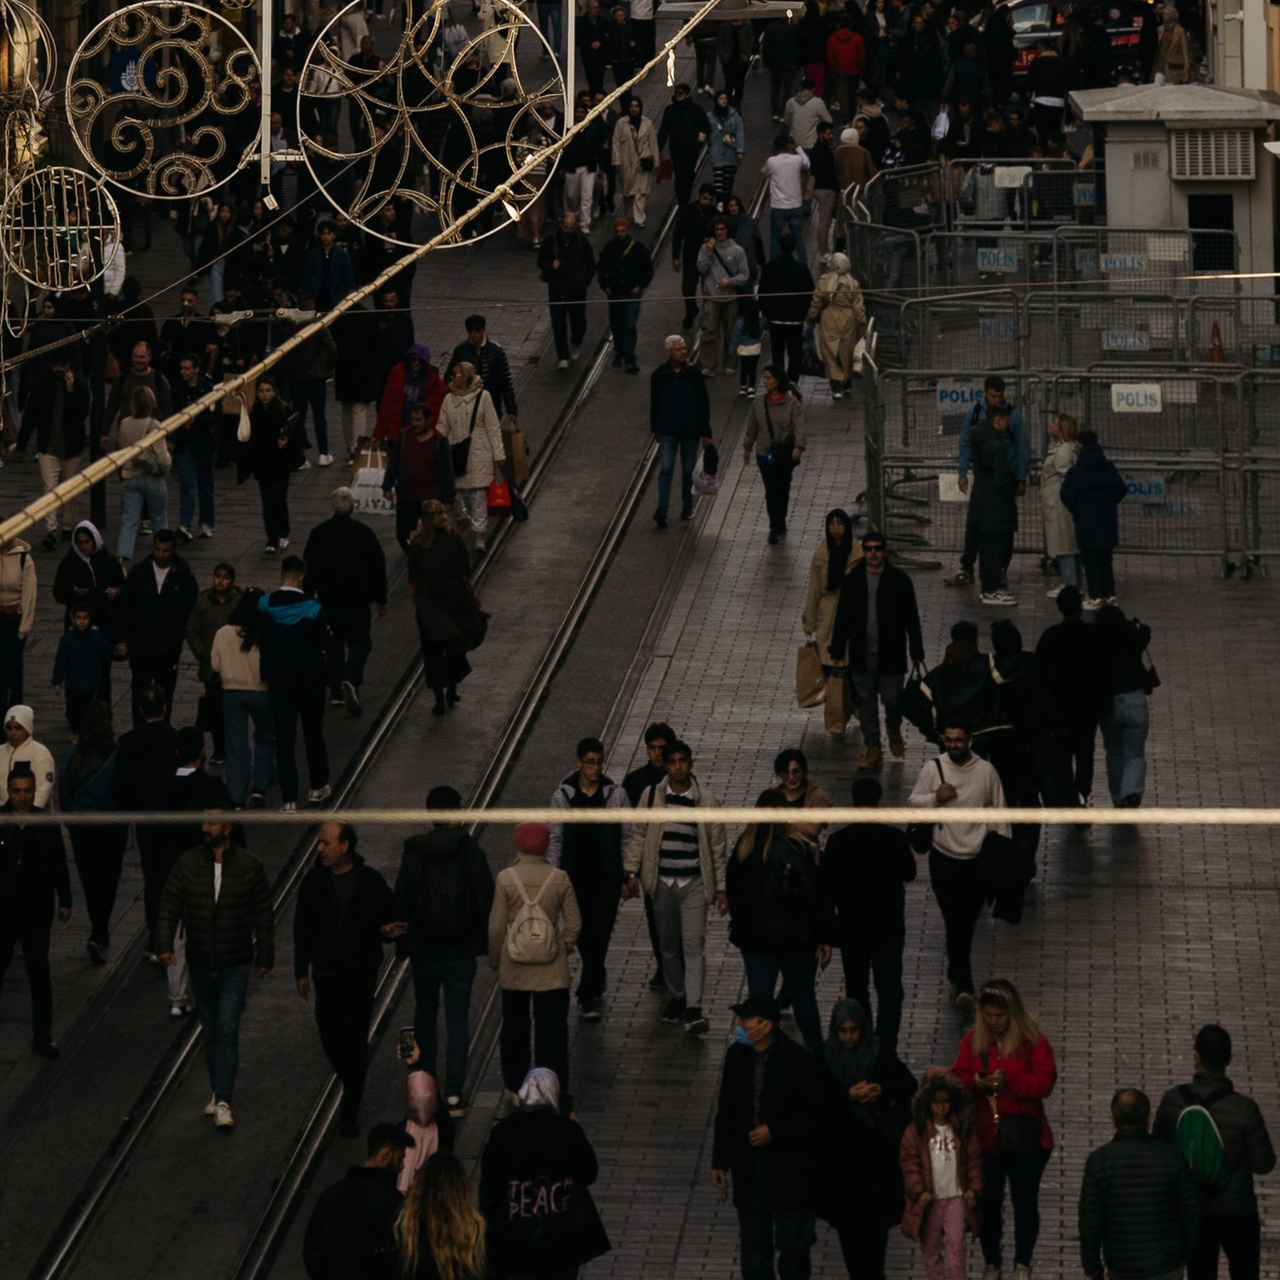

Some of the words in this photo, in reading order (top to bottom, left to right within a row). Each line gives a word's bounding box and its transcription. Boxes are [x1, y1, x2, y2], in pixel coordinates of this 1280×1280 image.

[1104, 259, 1144, 271] POLİS
[939, 389, 984, 403] POLİS
[1116, 391, 1158, 408] POLİS
[1127, 482, 1163, 495] OLİS
